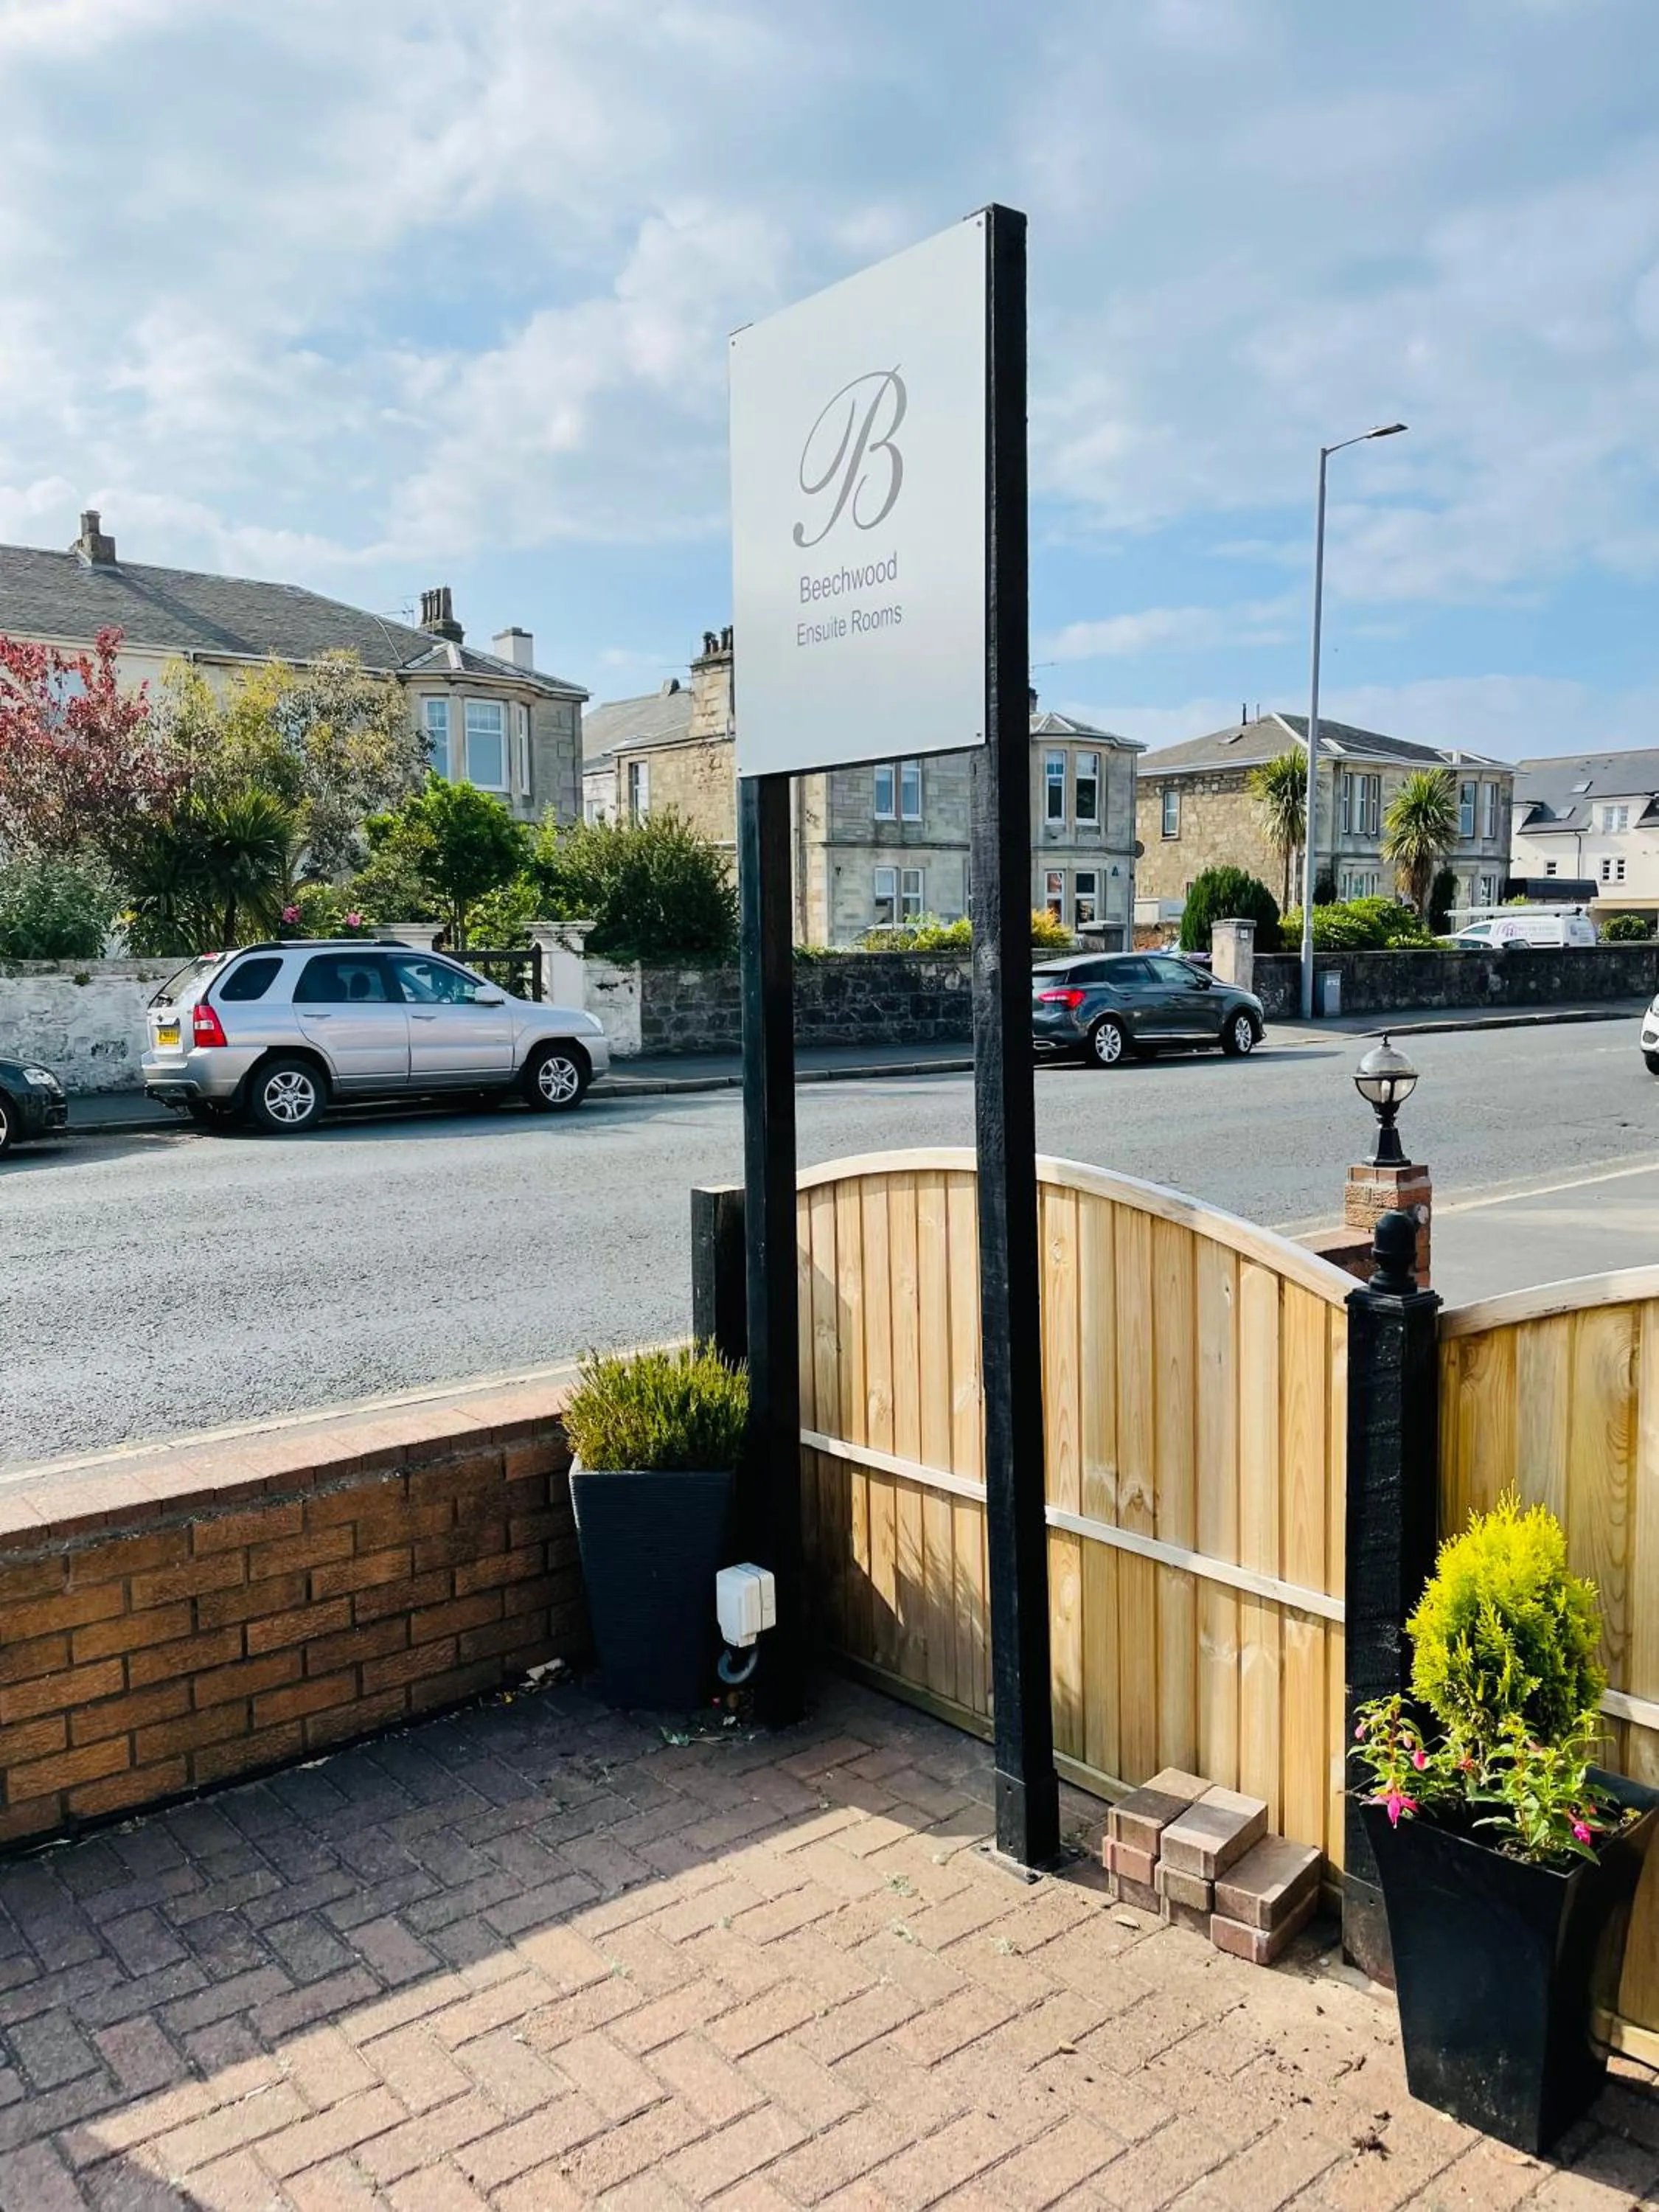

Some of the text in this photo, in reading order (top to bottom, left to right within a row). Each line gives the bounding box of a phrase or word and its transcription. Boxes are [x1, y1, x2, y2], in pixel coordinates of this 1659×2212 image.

[799, 551, 897, 604] Beechwood
[796, 605, 902, 647] Ensuite Rooms
